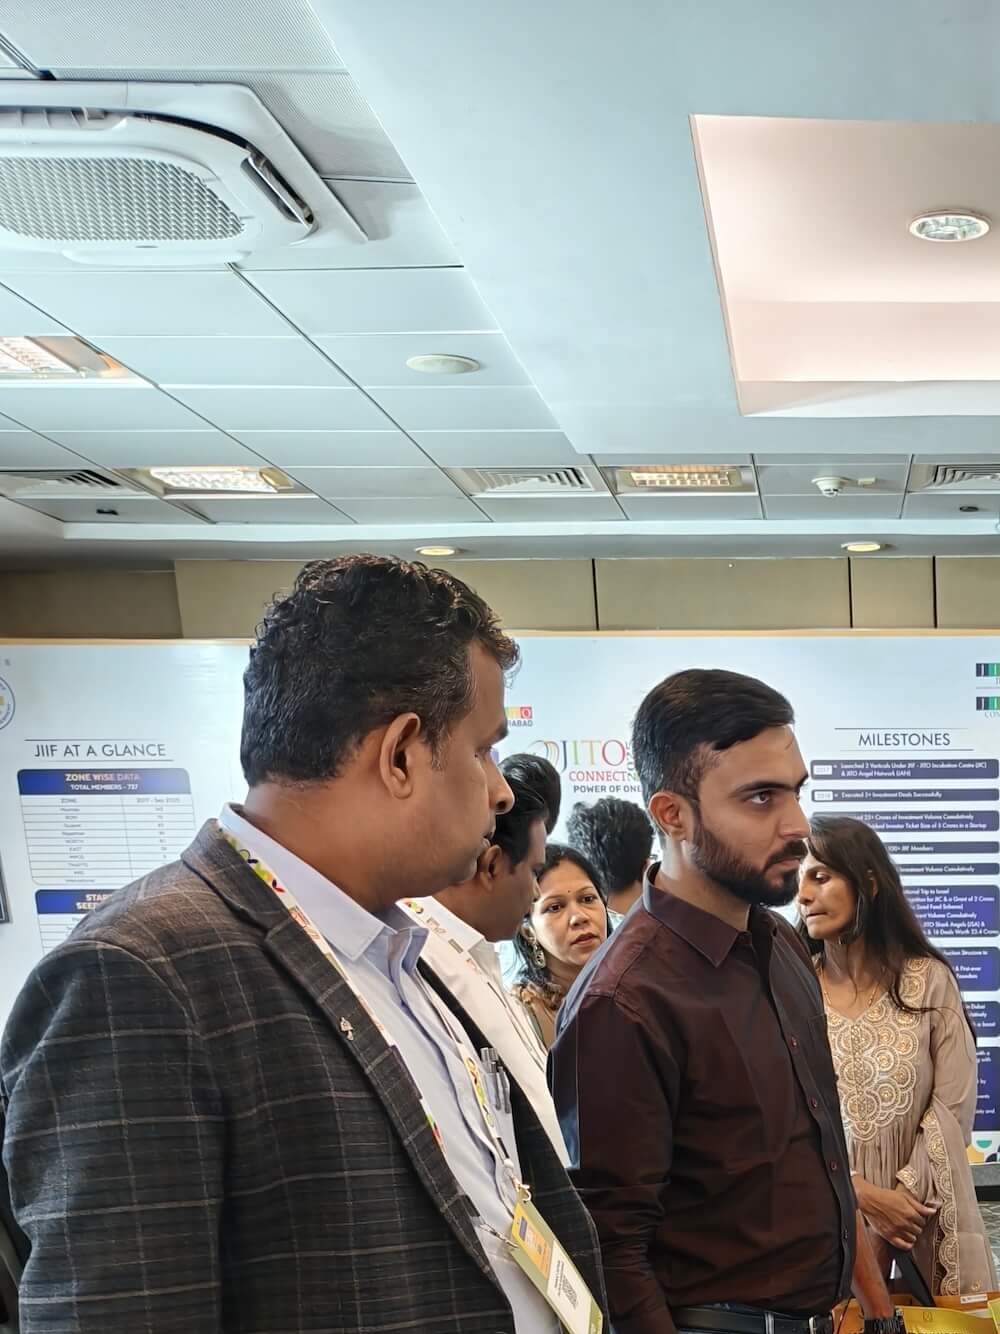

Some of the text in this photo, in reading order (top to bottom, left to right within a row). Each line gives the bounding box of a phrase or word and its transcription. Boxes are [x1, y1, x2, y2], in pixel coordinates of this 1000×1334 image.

[858, 733, 951, 746] MILESTONES
[34, 744, 166, 757] JIIF AT A GLANCE
[560, 739, 626, 774] JITO
[569, 770, 626, 782] CONNECT
[573, 785, 607, 793] POWER
[609, 785, 621, 793] OF
